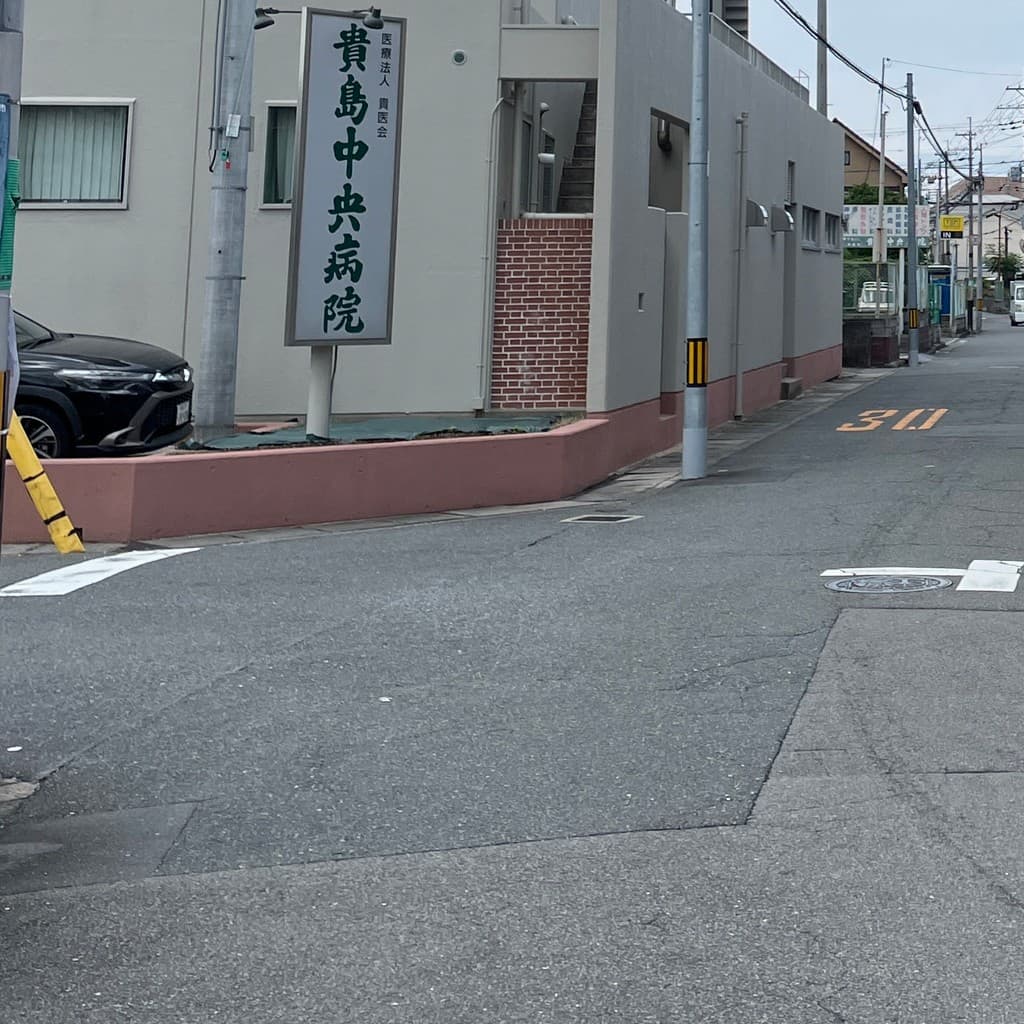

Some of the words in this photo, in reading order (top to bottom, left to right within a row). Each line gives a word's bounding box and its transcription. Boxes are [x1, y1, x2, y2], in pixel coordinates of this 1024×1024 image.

[379, 33, 392, 87] 医療法人
[323, 23, 371, 334] 貴島中央病院
[835, 408, 949, 432] 30
